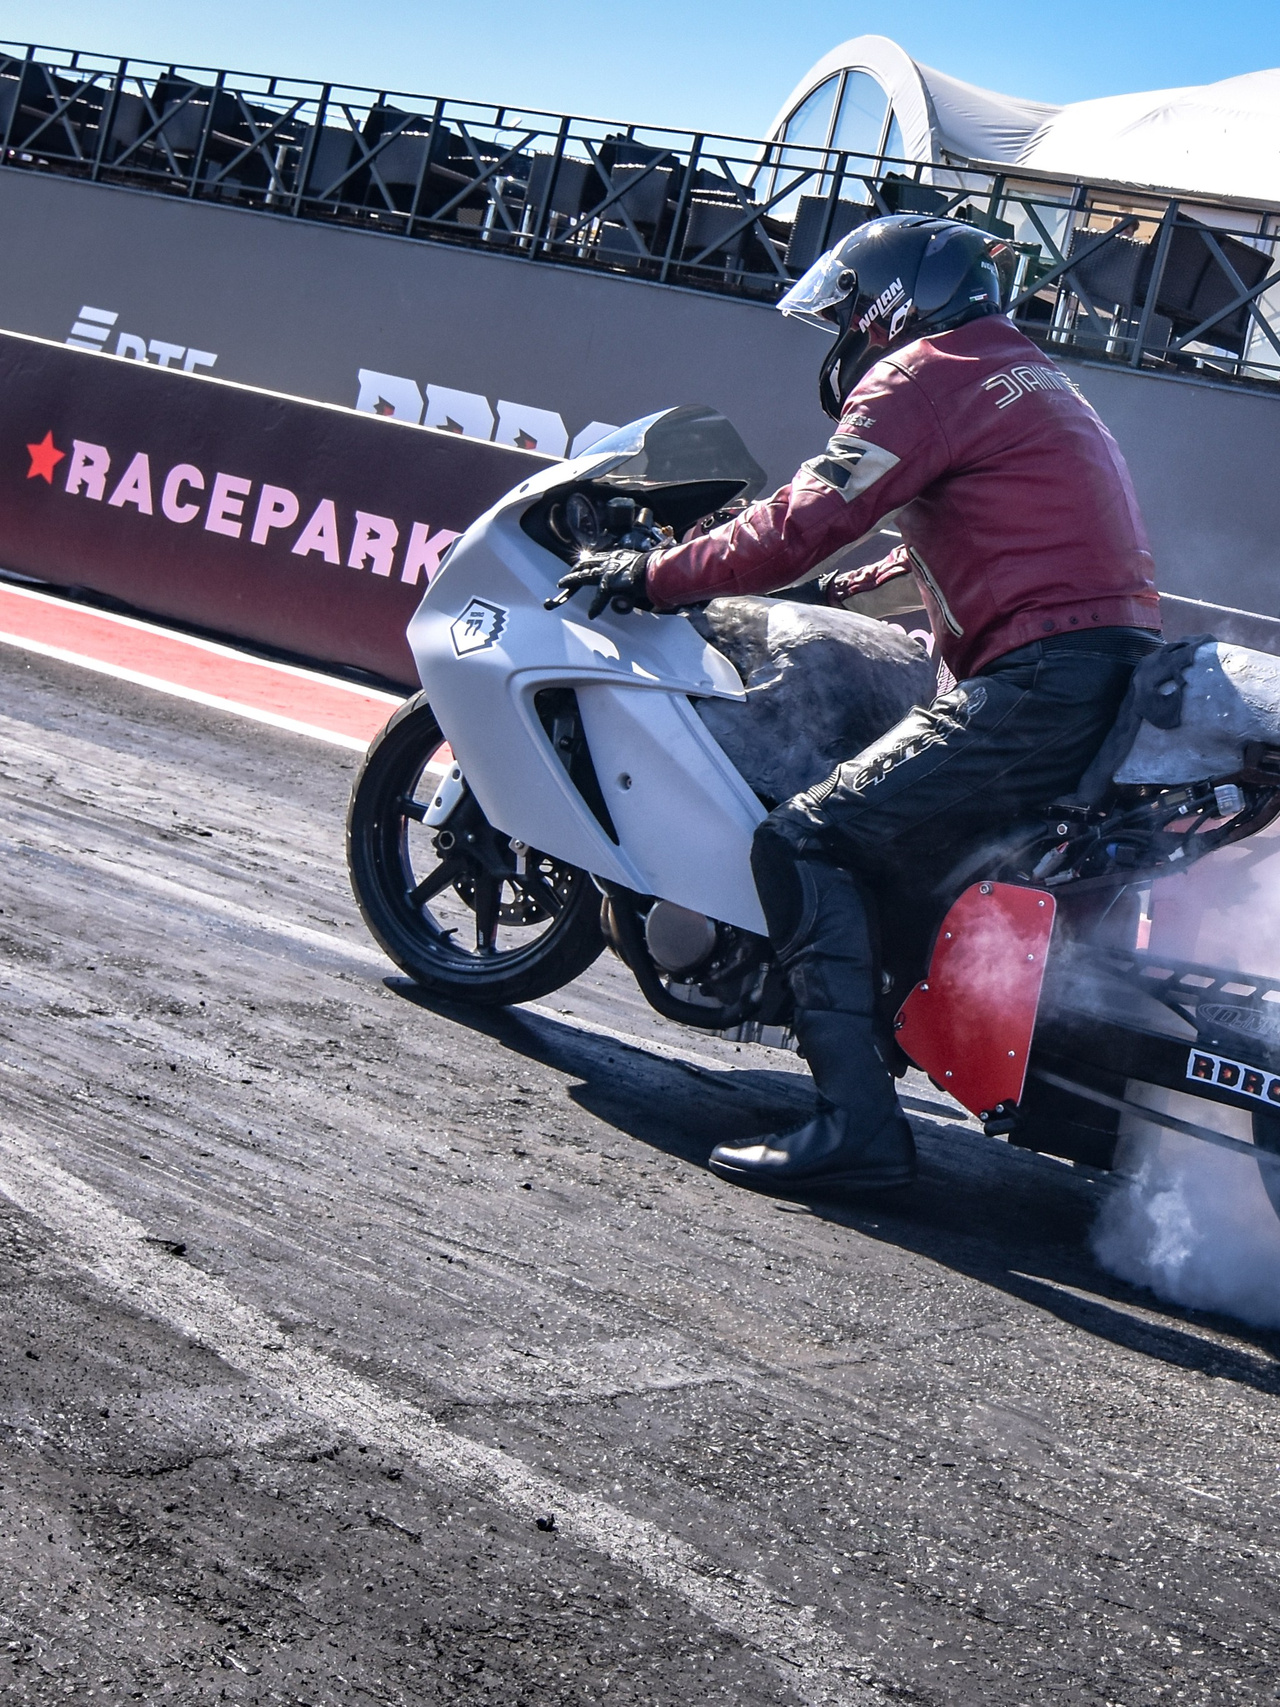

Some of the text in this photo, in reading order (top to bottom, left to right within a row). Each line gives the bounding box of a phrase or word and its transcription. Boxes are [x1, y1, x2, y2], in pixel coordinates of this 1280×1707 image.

[858, 277, 906, 334] NOLAN
[65, 439, 462, 585] RACEPARK
[464, 619, 483, 637] 77
